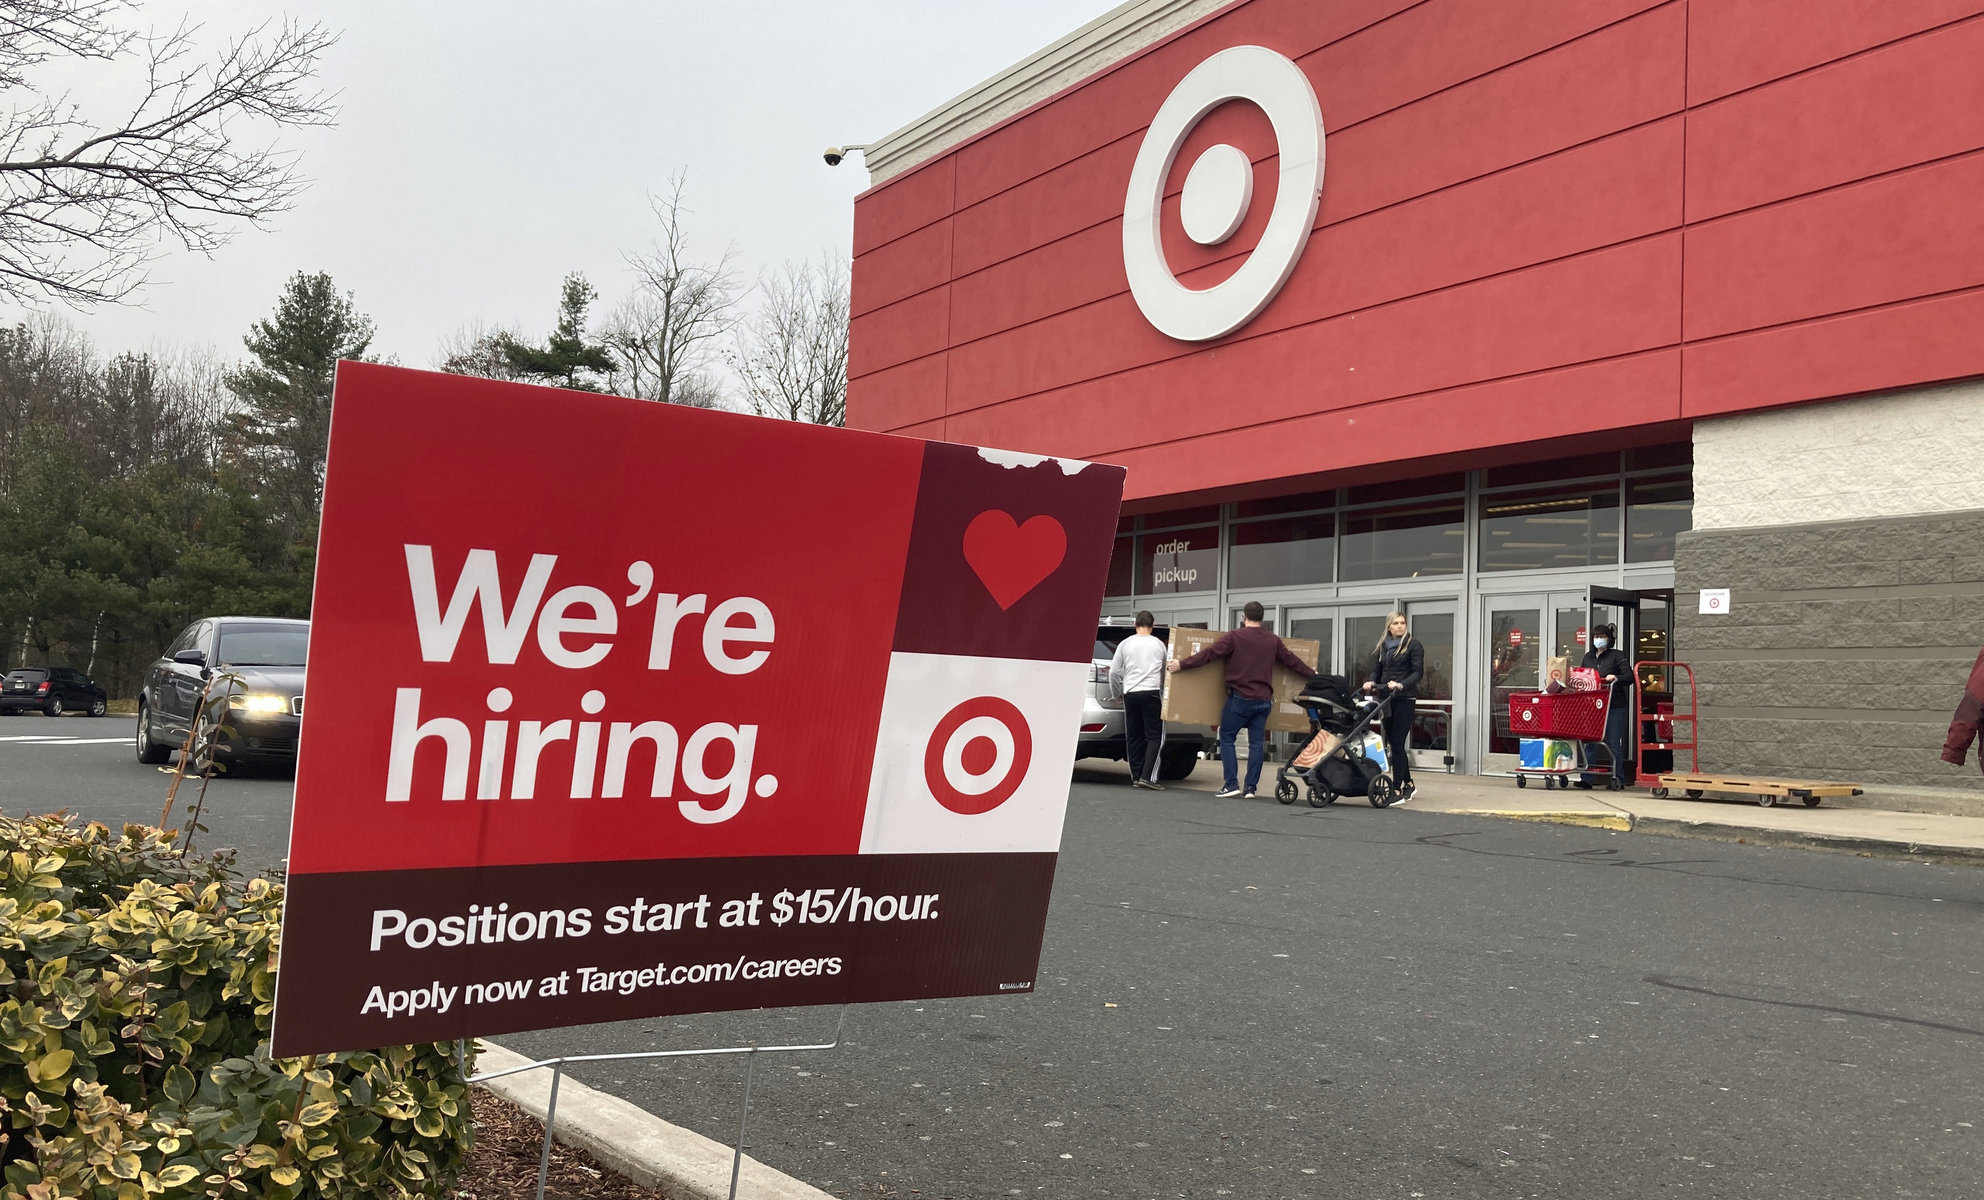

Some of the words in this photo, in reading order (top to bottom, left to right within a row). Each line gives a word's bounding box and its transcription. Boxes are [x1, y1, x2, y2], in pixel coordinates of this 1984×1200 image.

[1154, 566, 1197, 587] pickup
[1156, 538, 1191, 555] order
[404, 543, 776, 675] We're
[385, 687, 779, 825] hiring.
[370, 902, 593, 952] Positions
[603, 894, 712, 935] start
[719, 891, 764, 928] at
[769, 885, 940, 929] $15/hour.
[360, 979, 458, 1018] Apply
[464, 975, 534, 1005] now
[538, 969, 570, 997] at
[576, 955, 842, 996] Target.com/careers
